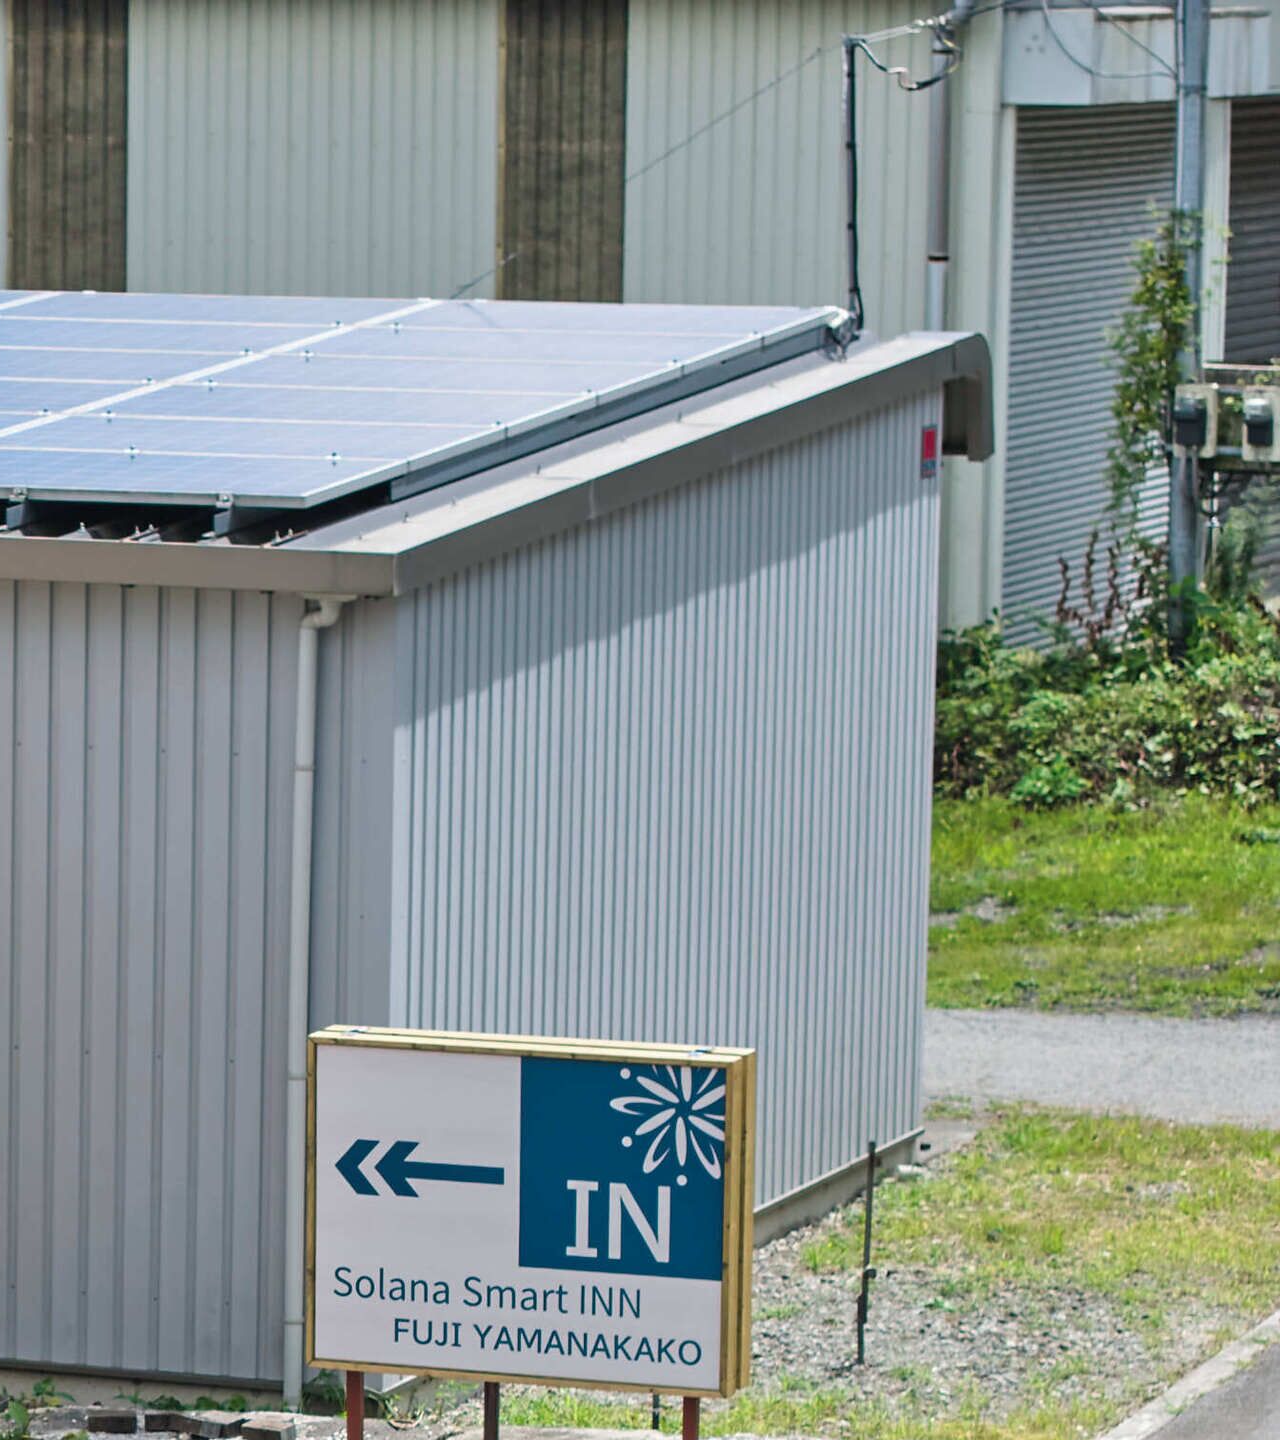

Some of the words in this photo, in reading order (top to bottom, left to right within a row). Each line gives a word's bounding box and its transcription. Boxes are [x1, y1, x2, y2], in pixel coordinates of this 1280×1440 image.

[566, 1180, 671, 1263] IN
[333, 1267, 450, 1305] Solana
[462, 1276, 569, 1314] Smart
[580, 1284, 641, 1319] INN
[393, 1318, 462, 1347] FUJI
[473, 1325, 703, 1366] YAMANAKAKO
